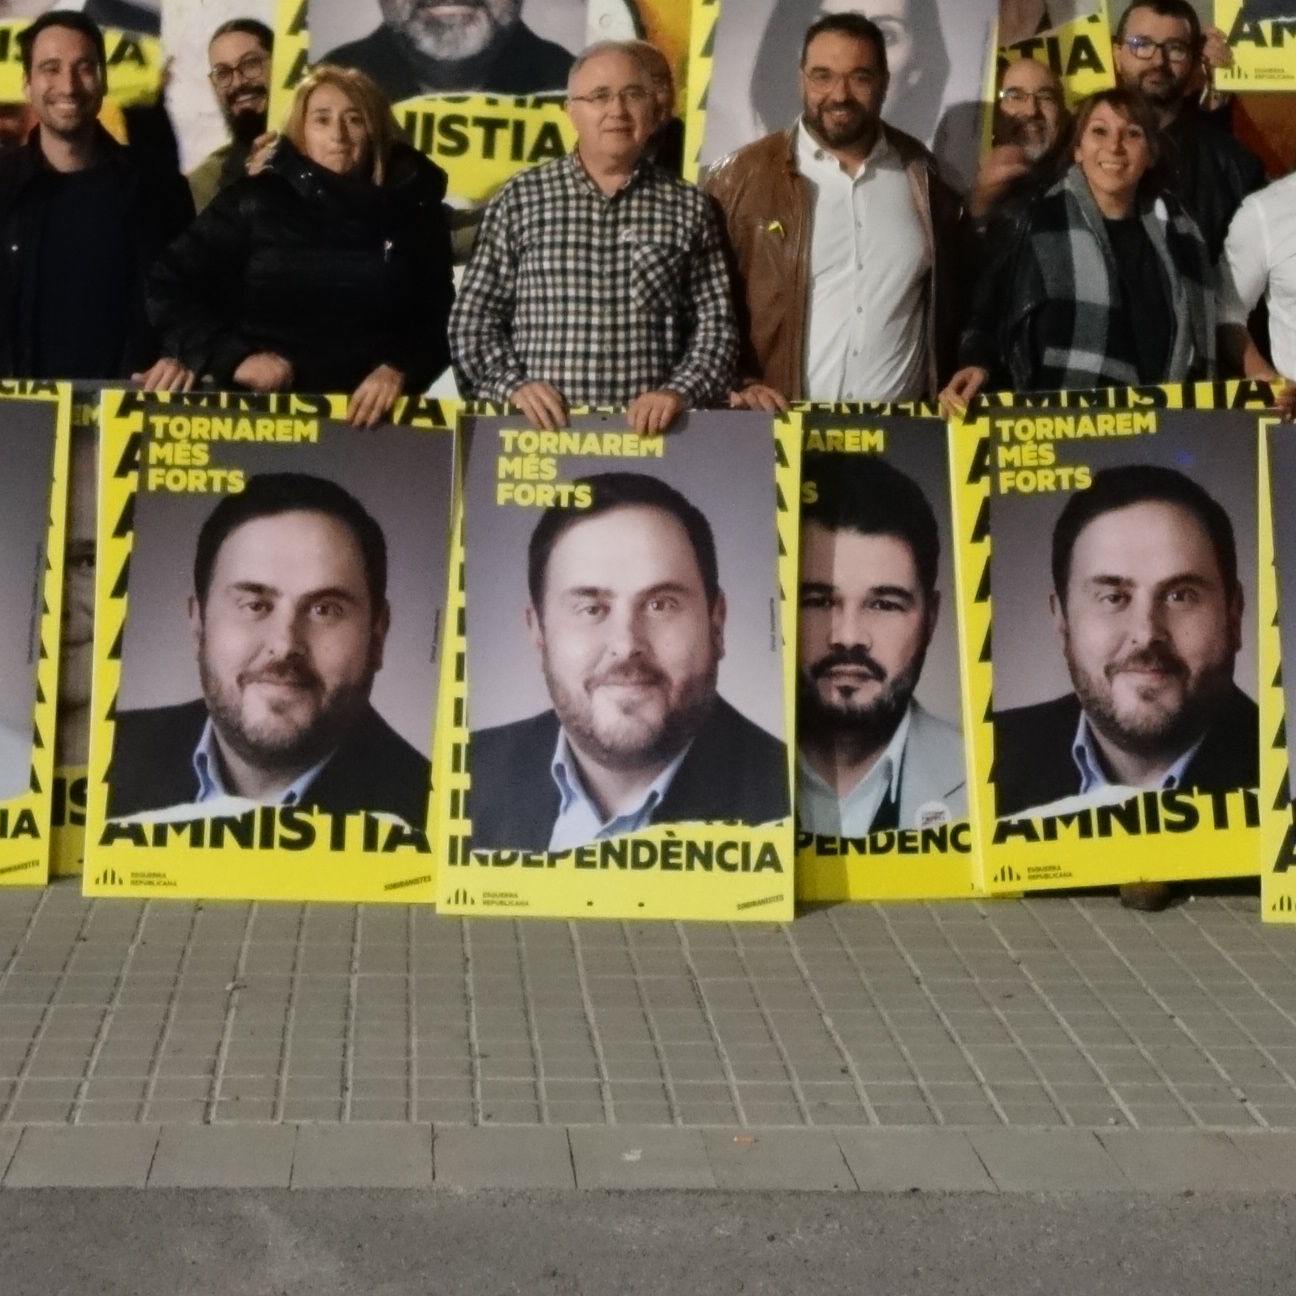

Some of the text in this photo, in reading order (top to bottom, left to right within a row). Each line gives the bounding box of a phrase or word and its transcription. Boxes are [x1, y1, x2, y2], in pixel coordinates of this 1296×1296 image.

[405, 111, 567, 162] ISTIA
[149, 416, 318, 442] TORNAREM
[996, 411, 1157, 442] TORNAREM
[149, 442, 209, 465] MÉS
[498, 430, 664, 458] TORNAREM
[998, 441, 1055, 468] MÉS
[498, 453, 557, 479] MÉS
[148, 469, 245, 493] FORTS
[999, 467, 1092, 493] FORTS
[497, 484, 591, 508] FORTS
[99, 804, 433, 854] AMNISTIA
[993, 788, 1261, 845] AMNISTI
